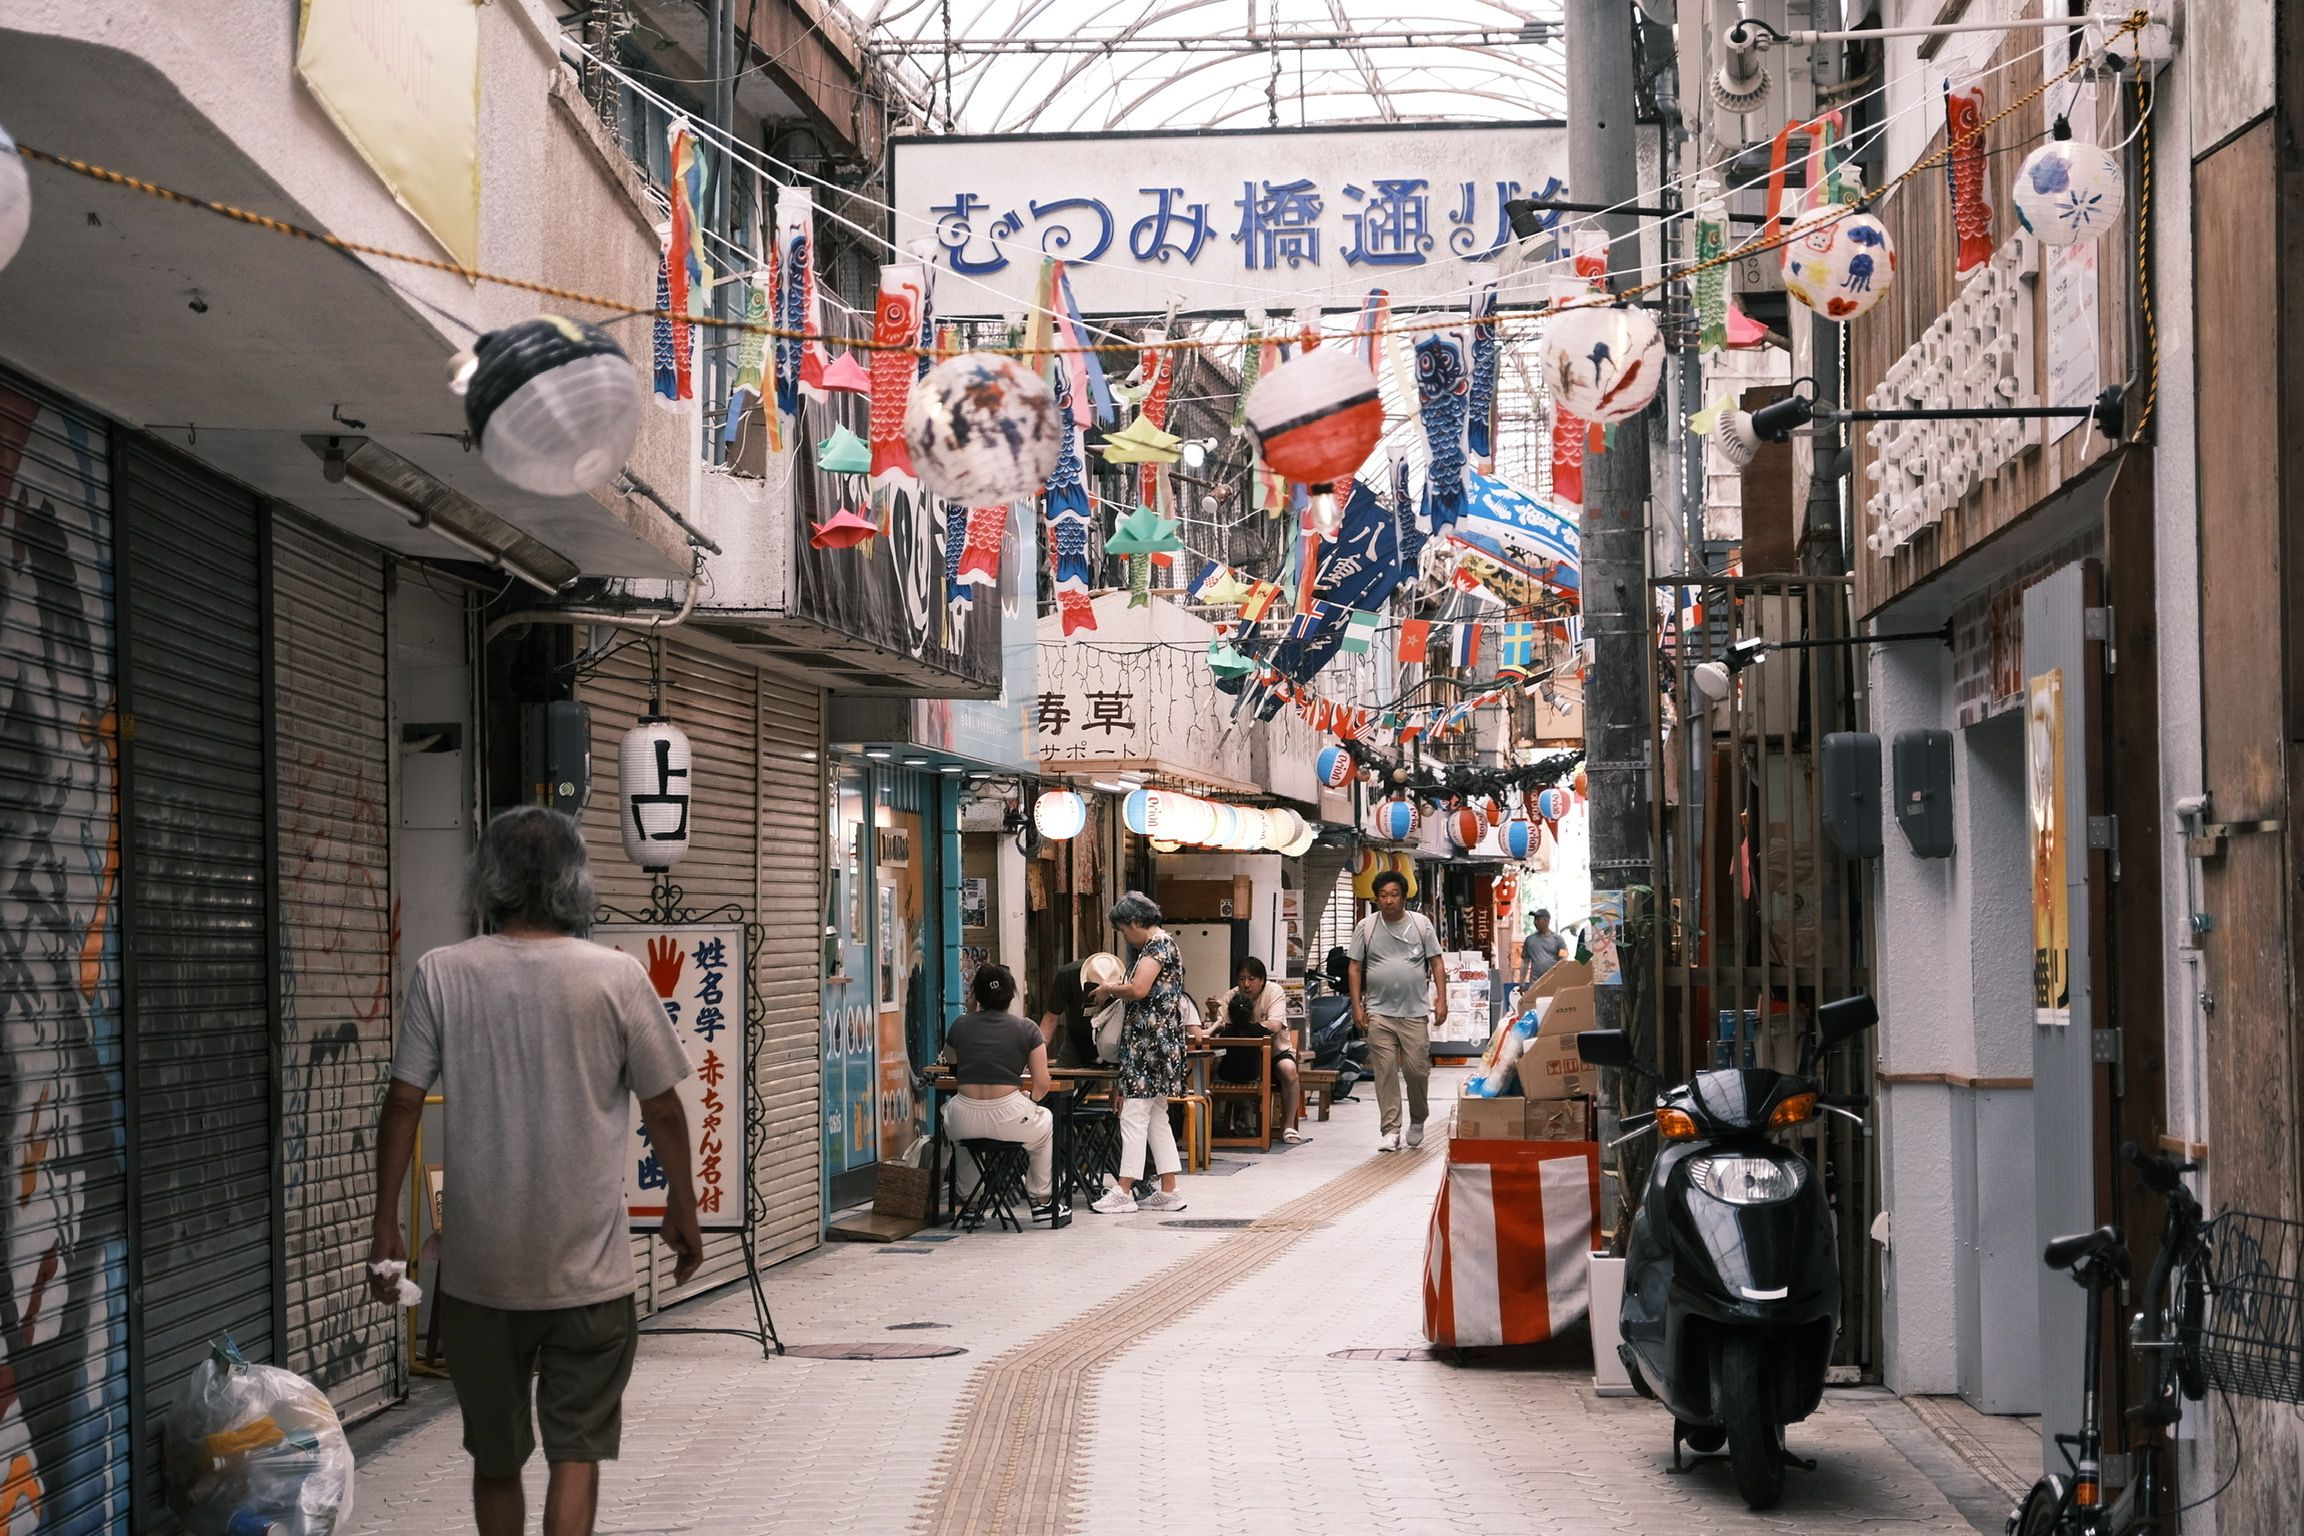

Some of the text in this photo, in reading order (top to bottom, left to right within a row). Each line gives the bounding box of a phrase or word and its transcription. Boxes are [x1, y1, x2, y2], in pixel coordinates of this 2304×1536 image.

[1040, 740, 1136, 761] サポート
[1331, 754, 1348, 781] Orion
